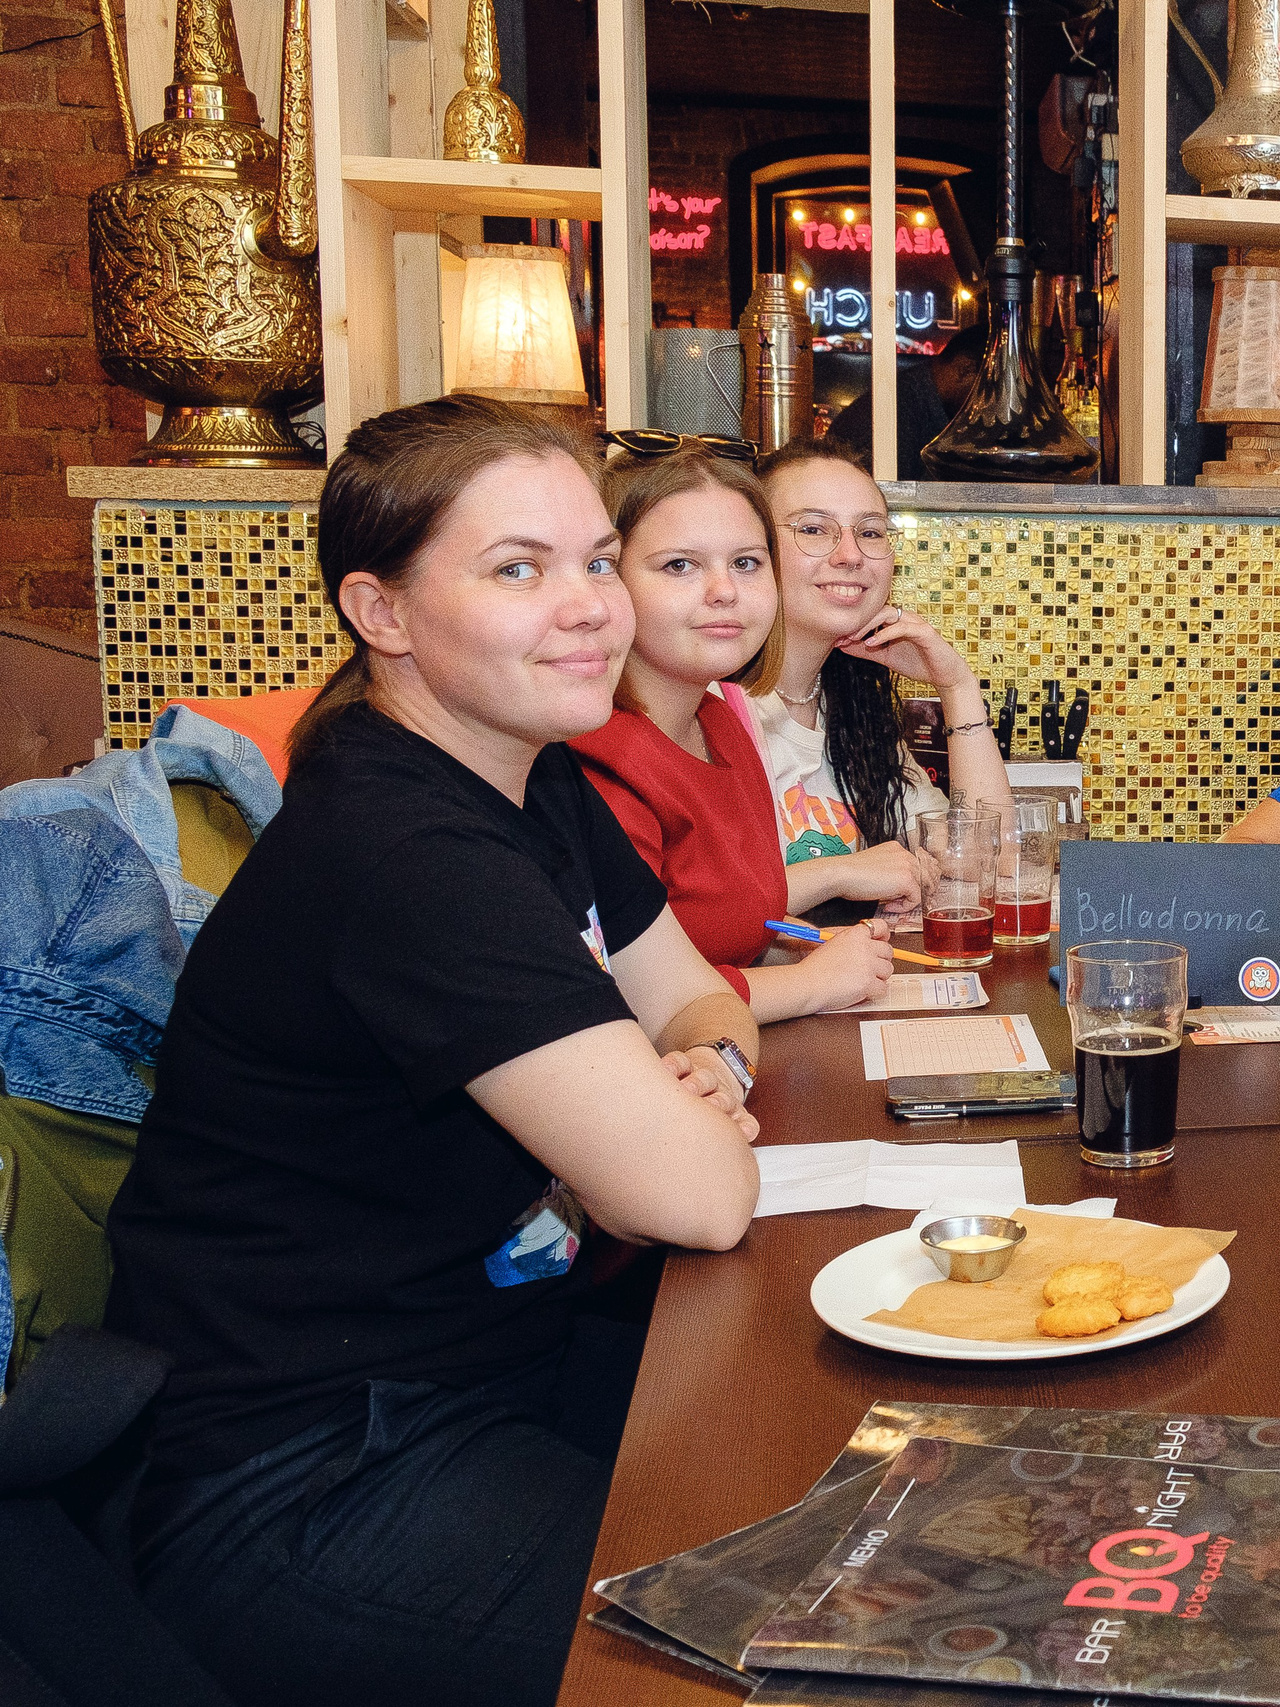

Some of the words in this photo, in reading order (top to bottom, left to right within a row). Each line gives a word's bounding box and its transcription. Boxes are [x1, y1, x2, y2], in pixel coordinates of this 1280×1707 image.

[648, 187, 679, 212] t's
[681, 197, 722, 220] your
[649, 224, 711, 250] oison?
[1077, 887, 1270, 937] Belladonna
[1154, 1420, 1192, 1460] BAR
[1146, 1466, 1195, 1528] NIGHT
[842, 1529, 890, 1568] МЕНЮ
[1200, 1535, 1238, 1583] quality
[1063, 1528, 1211, 1614] BQ
[1178, 1603, 1203, 1619] to
[1186, 1583, 1212, 1602] be
[1075, 1618, 1127, 1664] BAR
